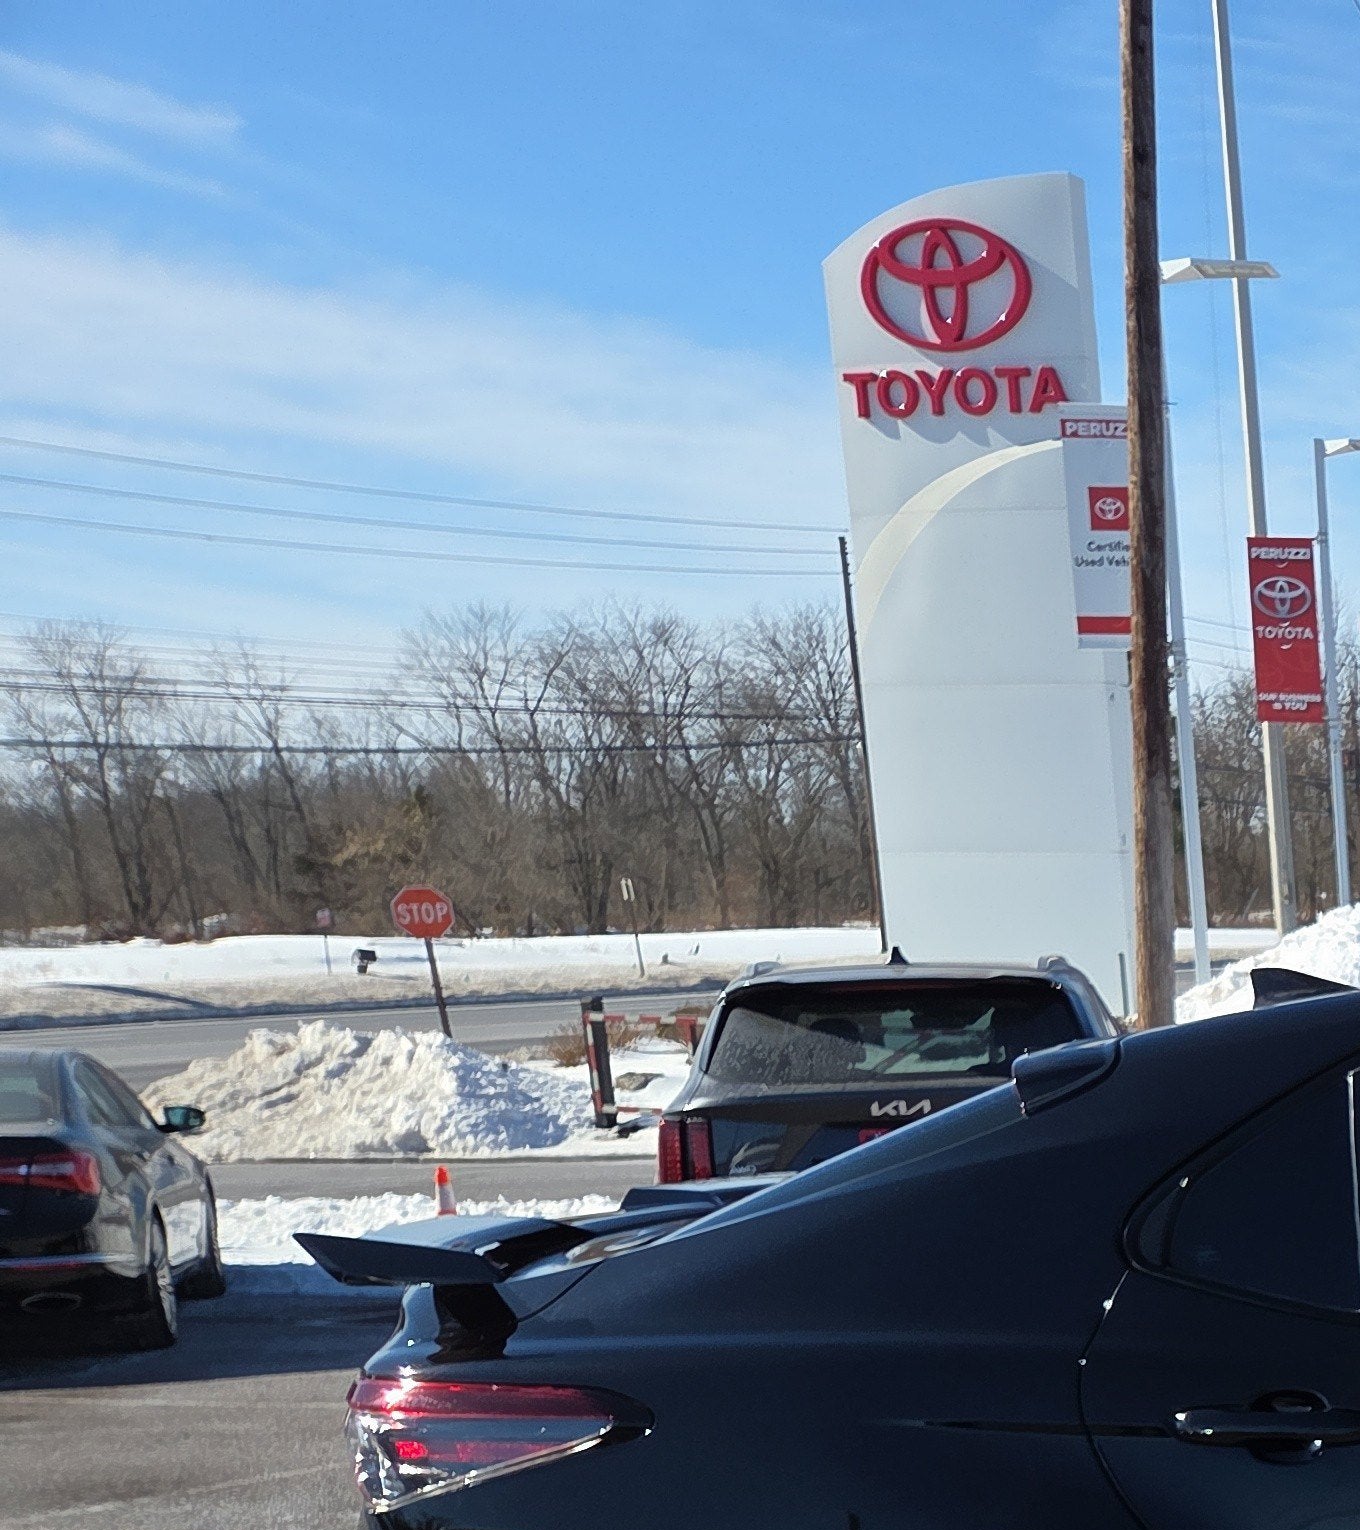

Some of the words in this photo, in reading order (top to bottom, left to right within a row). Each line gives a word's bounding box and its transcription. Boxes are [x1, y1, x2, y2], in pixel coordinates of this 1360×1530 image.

[842, 366, 1071, 420] TOYOTA
[1065, 420, 1130, 437] PERUZ
[1250, 547, 1311, 560] PERUZZI
[1255, 625, 1315, 640] TOYOTA
[1284, 701, 1308, 711] YOU
[397, 902, 448, 925] STOP
[870, 1099, 932, 1117] KIA
